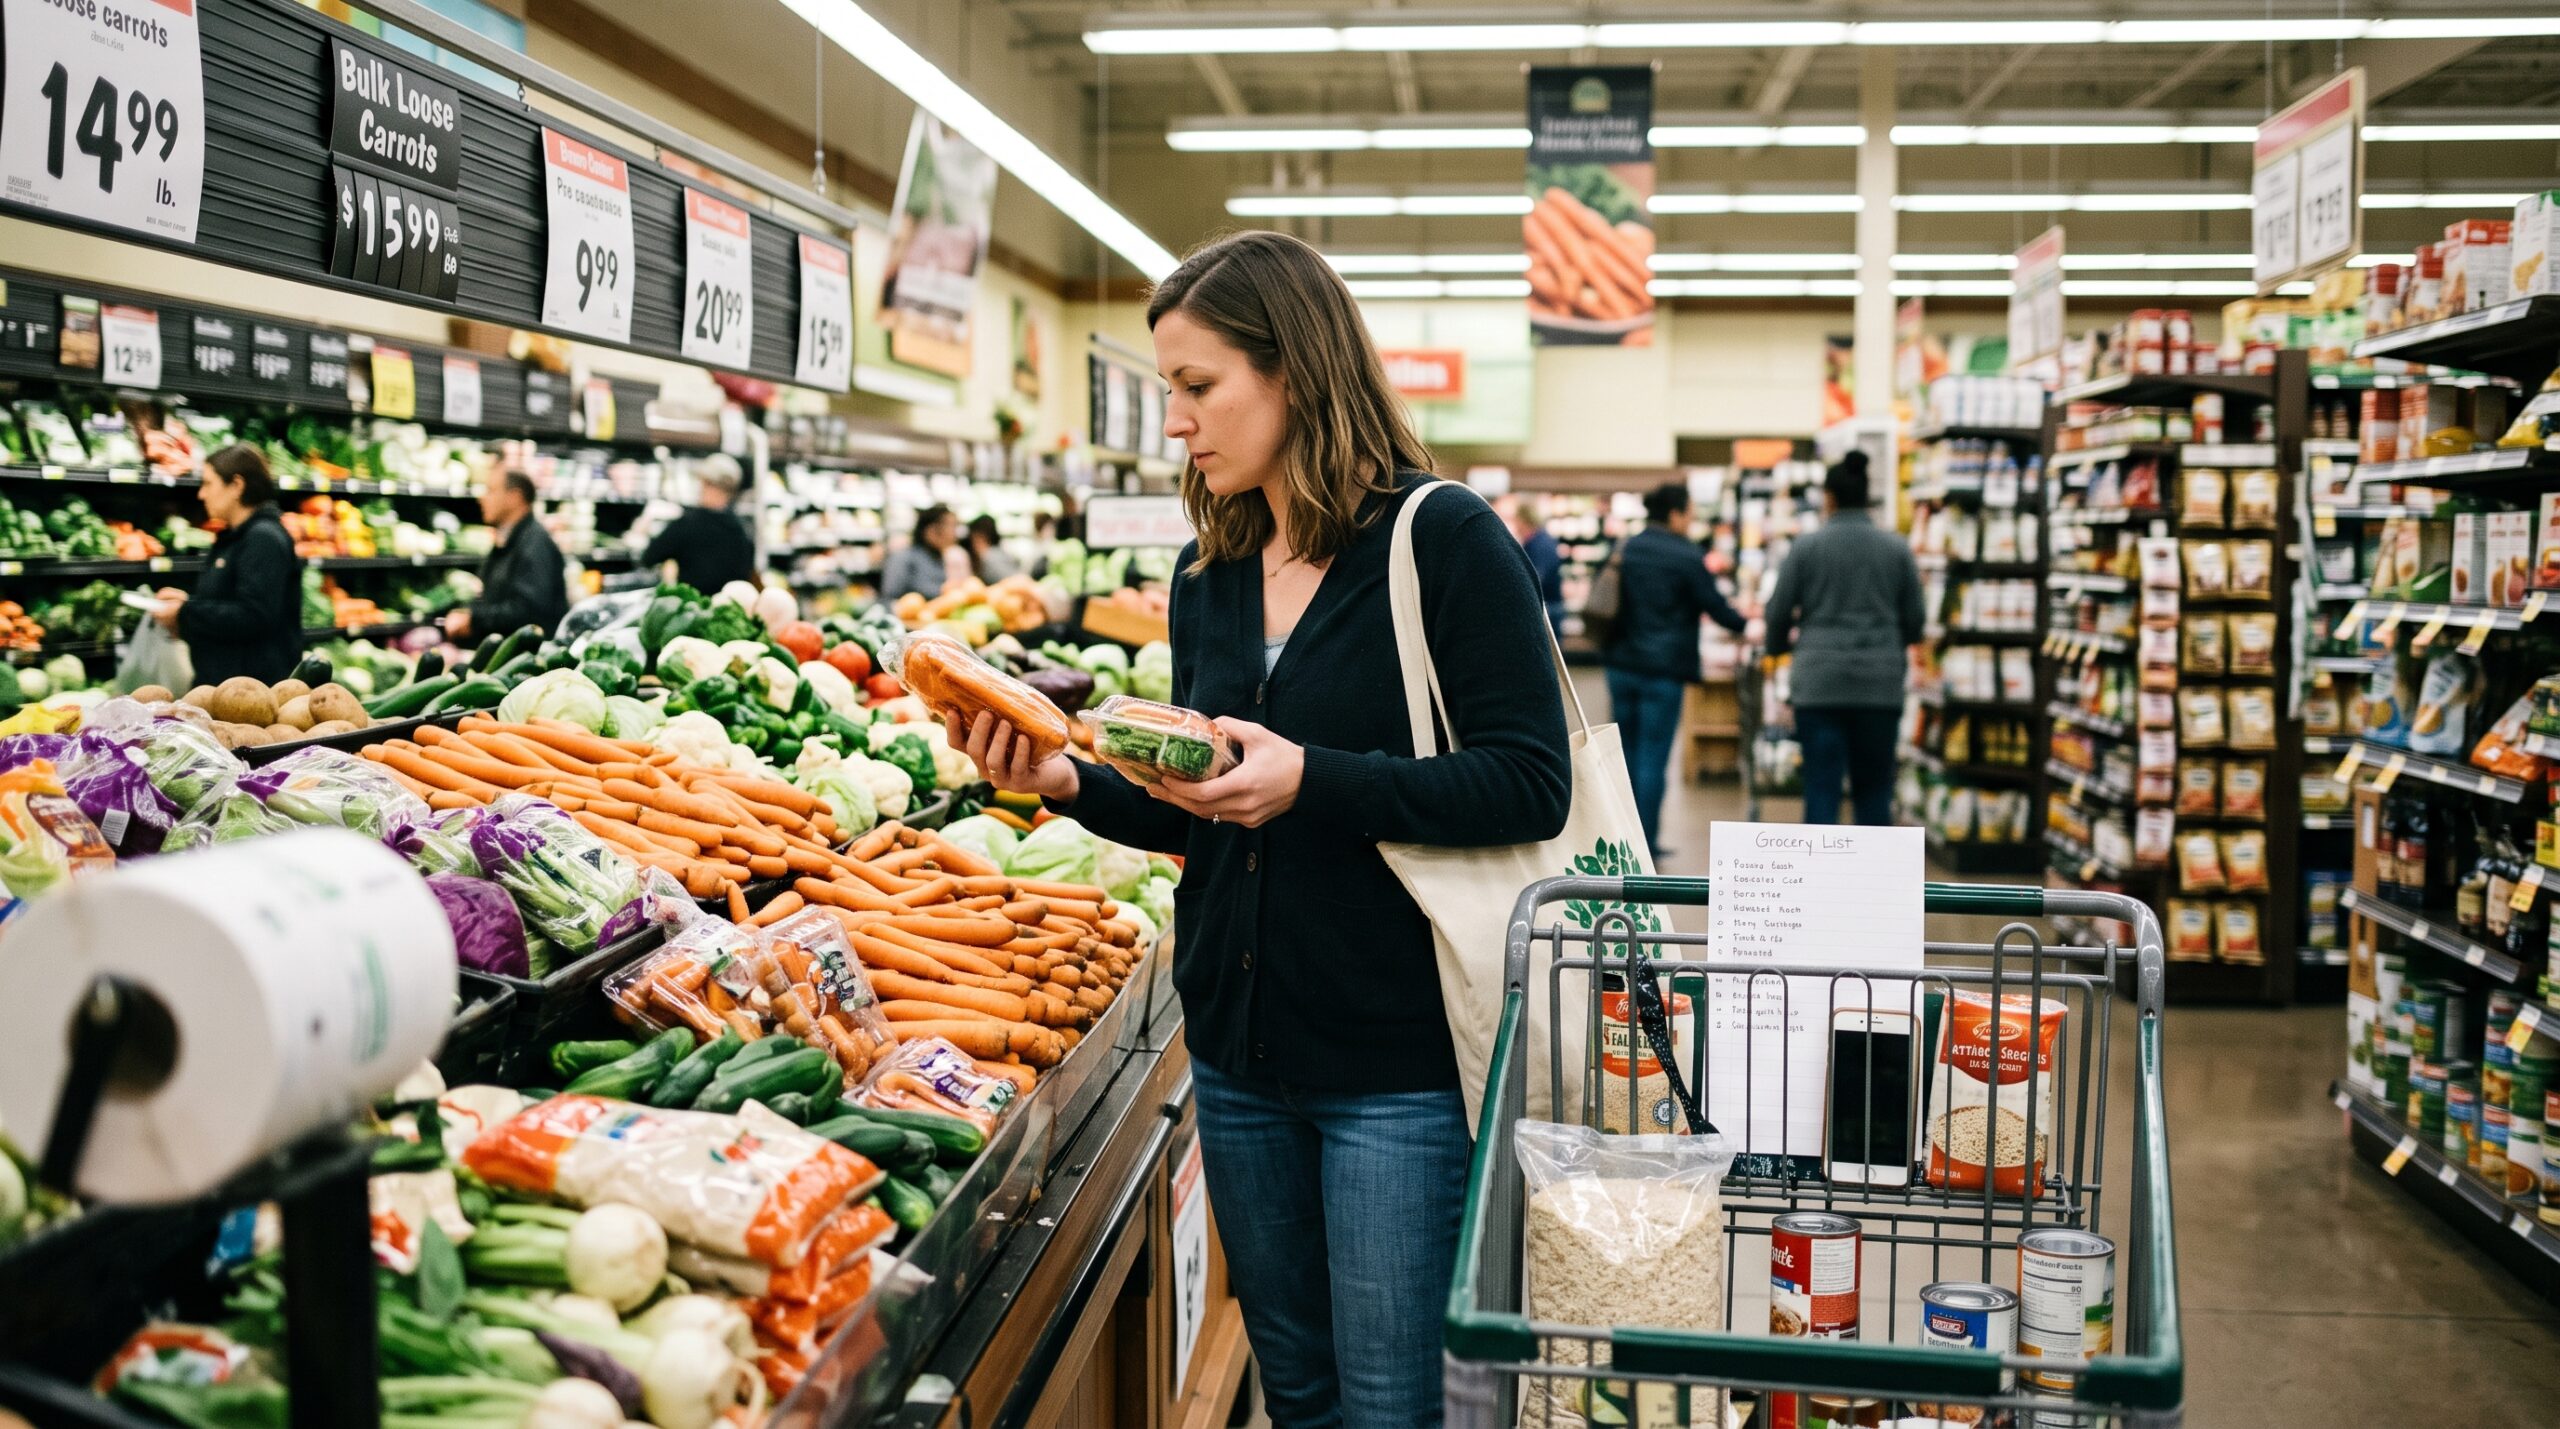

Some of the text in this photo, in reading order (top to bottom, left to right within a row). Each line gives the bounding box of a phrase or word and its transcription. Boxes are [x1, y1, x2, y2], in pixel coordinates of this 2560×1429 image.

[43, 0, 96, 20] oose
[103, 6, 168, 48] carrots
[340, 49, 454, 132] Bulk Loose
[359, 109, 438, 174] Carrots
[1756, 831, 1854, 856] Grocery List
